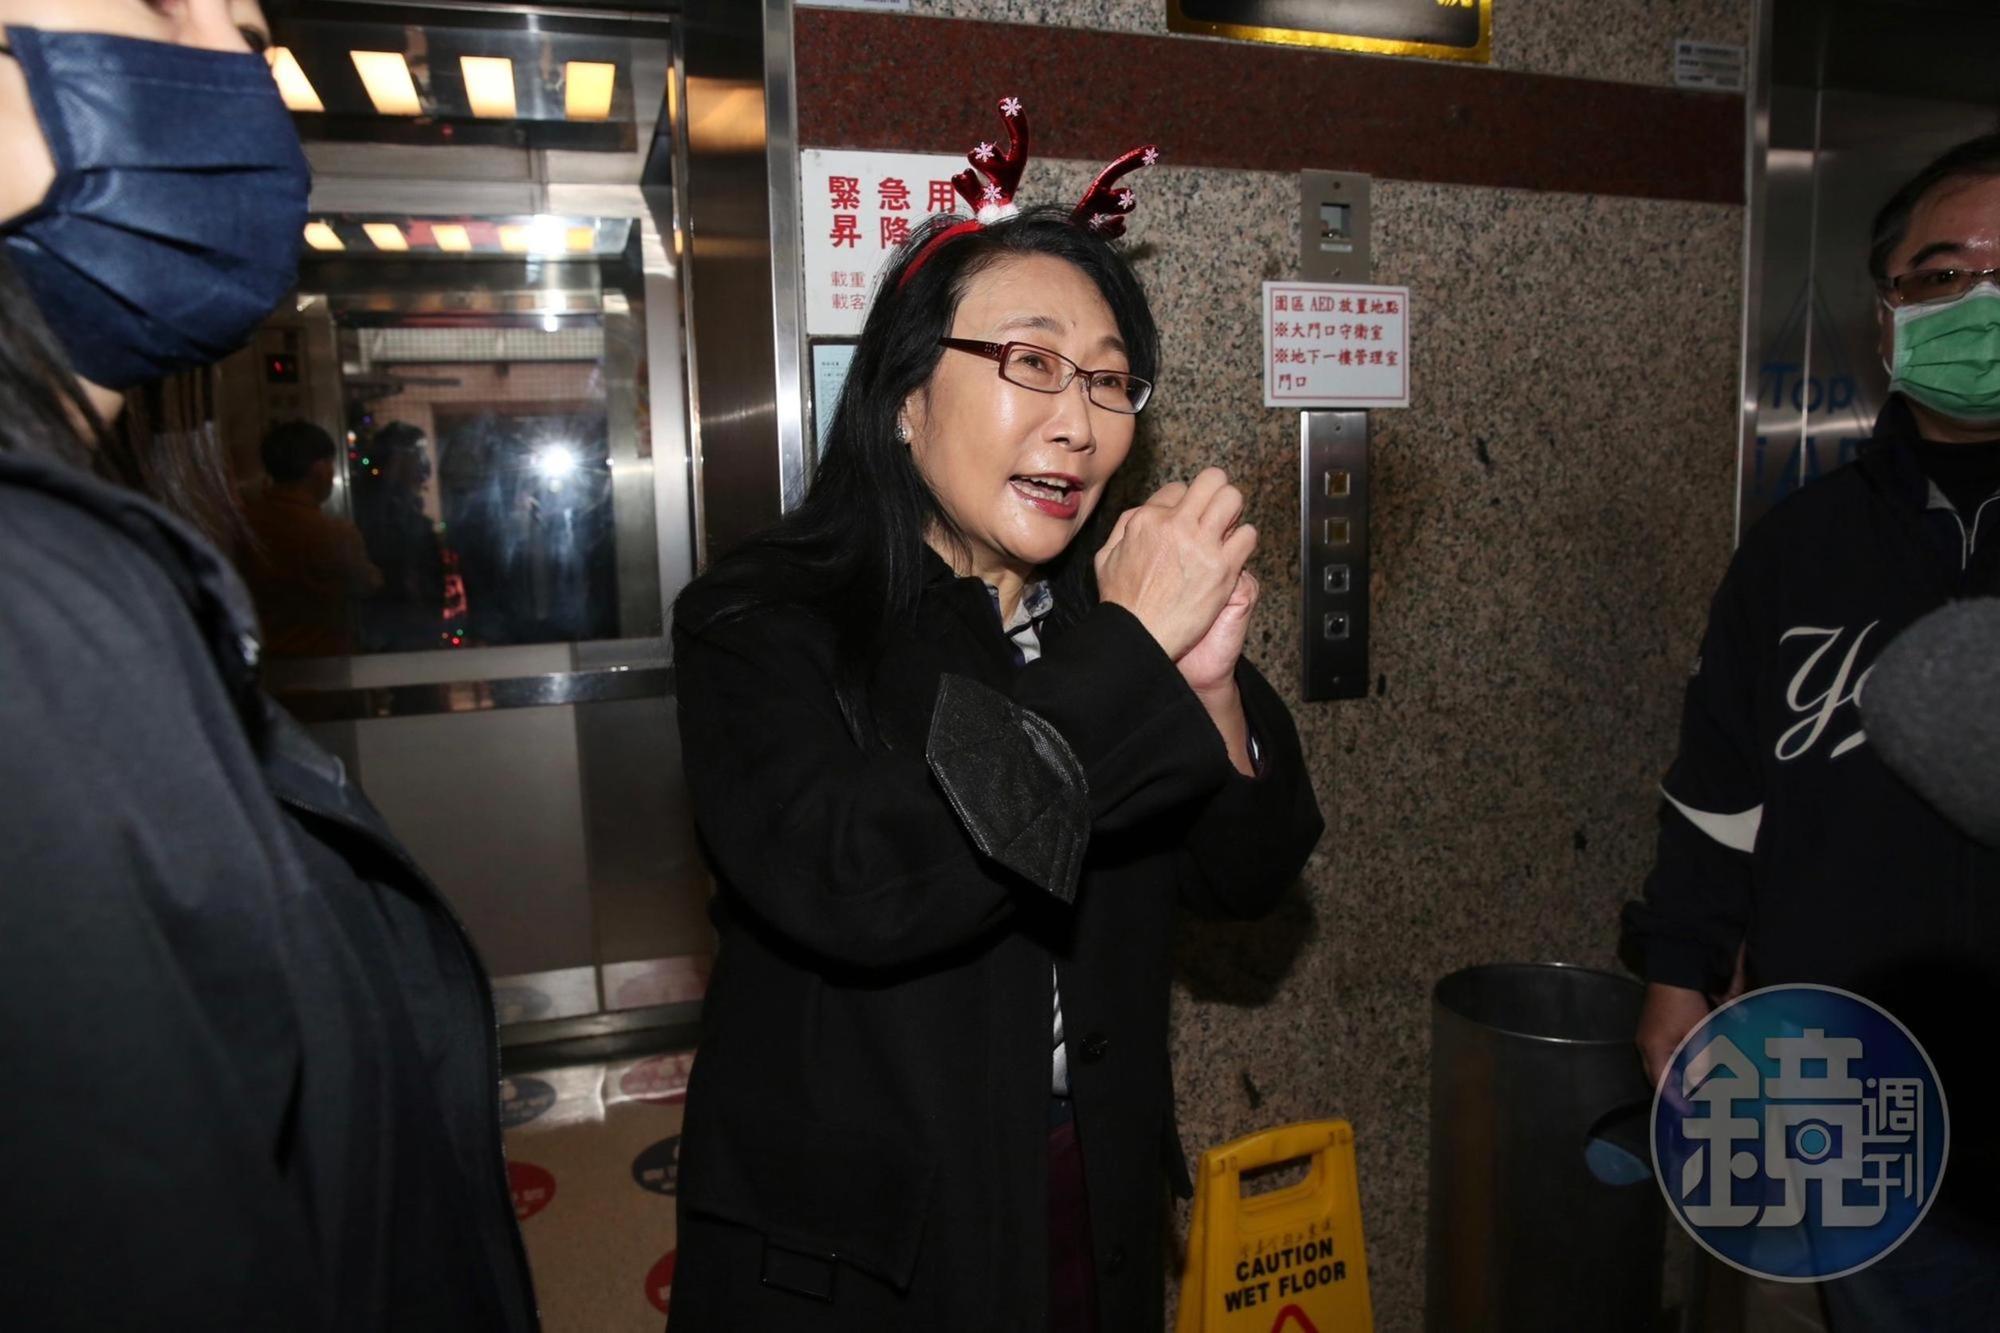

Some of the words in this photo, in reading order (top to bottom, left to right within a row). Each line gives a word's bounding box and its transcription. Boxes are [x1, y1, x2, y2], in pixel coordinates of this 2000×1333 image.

[829, 175, 957, 214] 緊急用
[829, 214, 948, 250] 昇降
[1310, 296, 1335, 312] AED
[1278, 373, 1307, 391] 門口
[1235, 1237, 1334, 1282] CAUTION
[1224, 1282, 1270, 1313] WET
[1278, 1261, 1347, 1298] FLOOR
